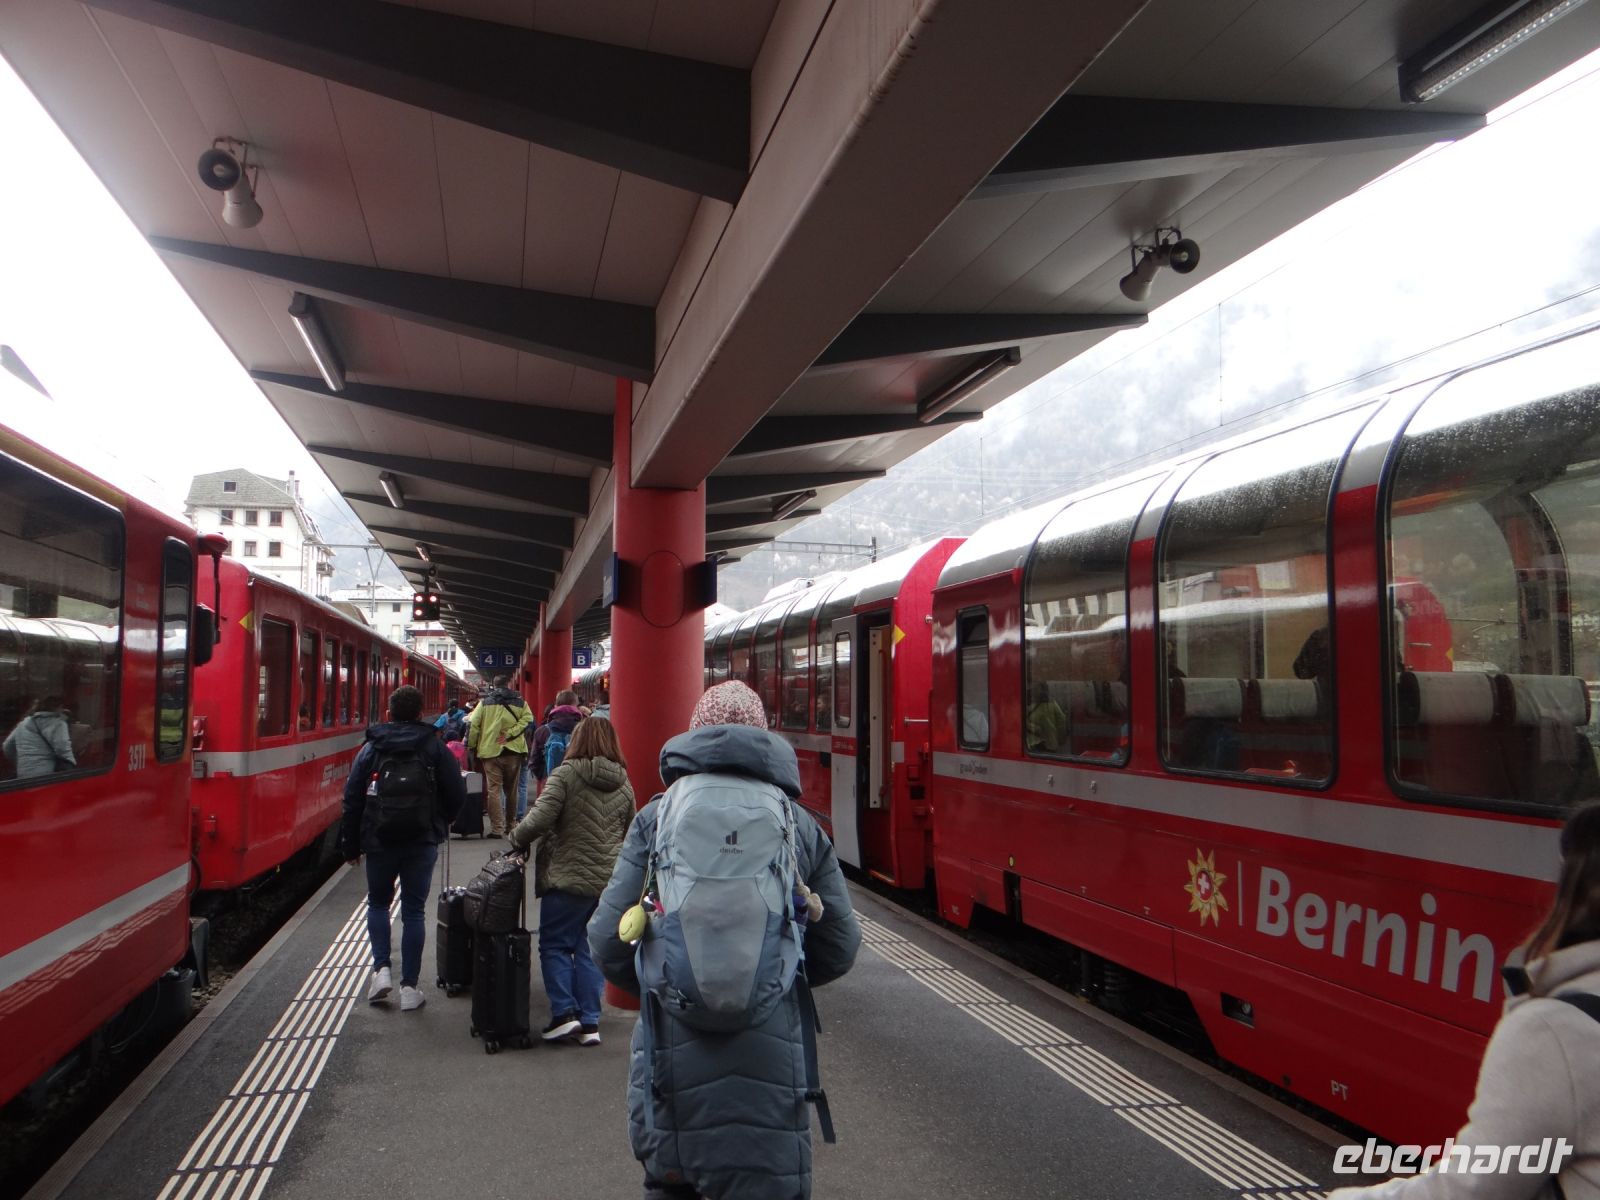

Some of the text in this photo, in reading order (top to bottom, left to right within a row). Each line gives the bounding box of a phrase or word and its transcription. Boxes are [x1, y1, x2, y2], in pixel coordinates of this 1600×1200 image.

[484, 655, 494, 665] 4
[505, 655, 514, 665] B
[577, 655, 586, 666] B
[128, 743, 146, 771] 3511
[1256, 866, 1526, 1004] Bernin
[1330, 1079, 1349, 1101] PT
